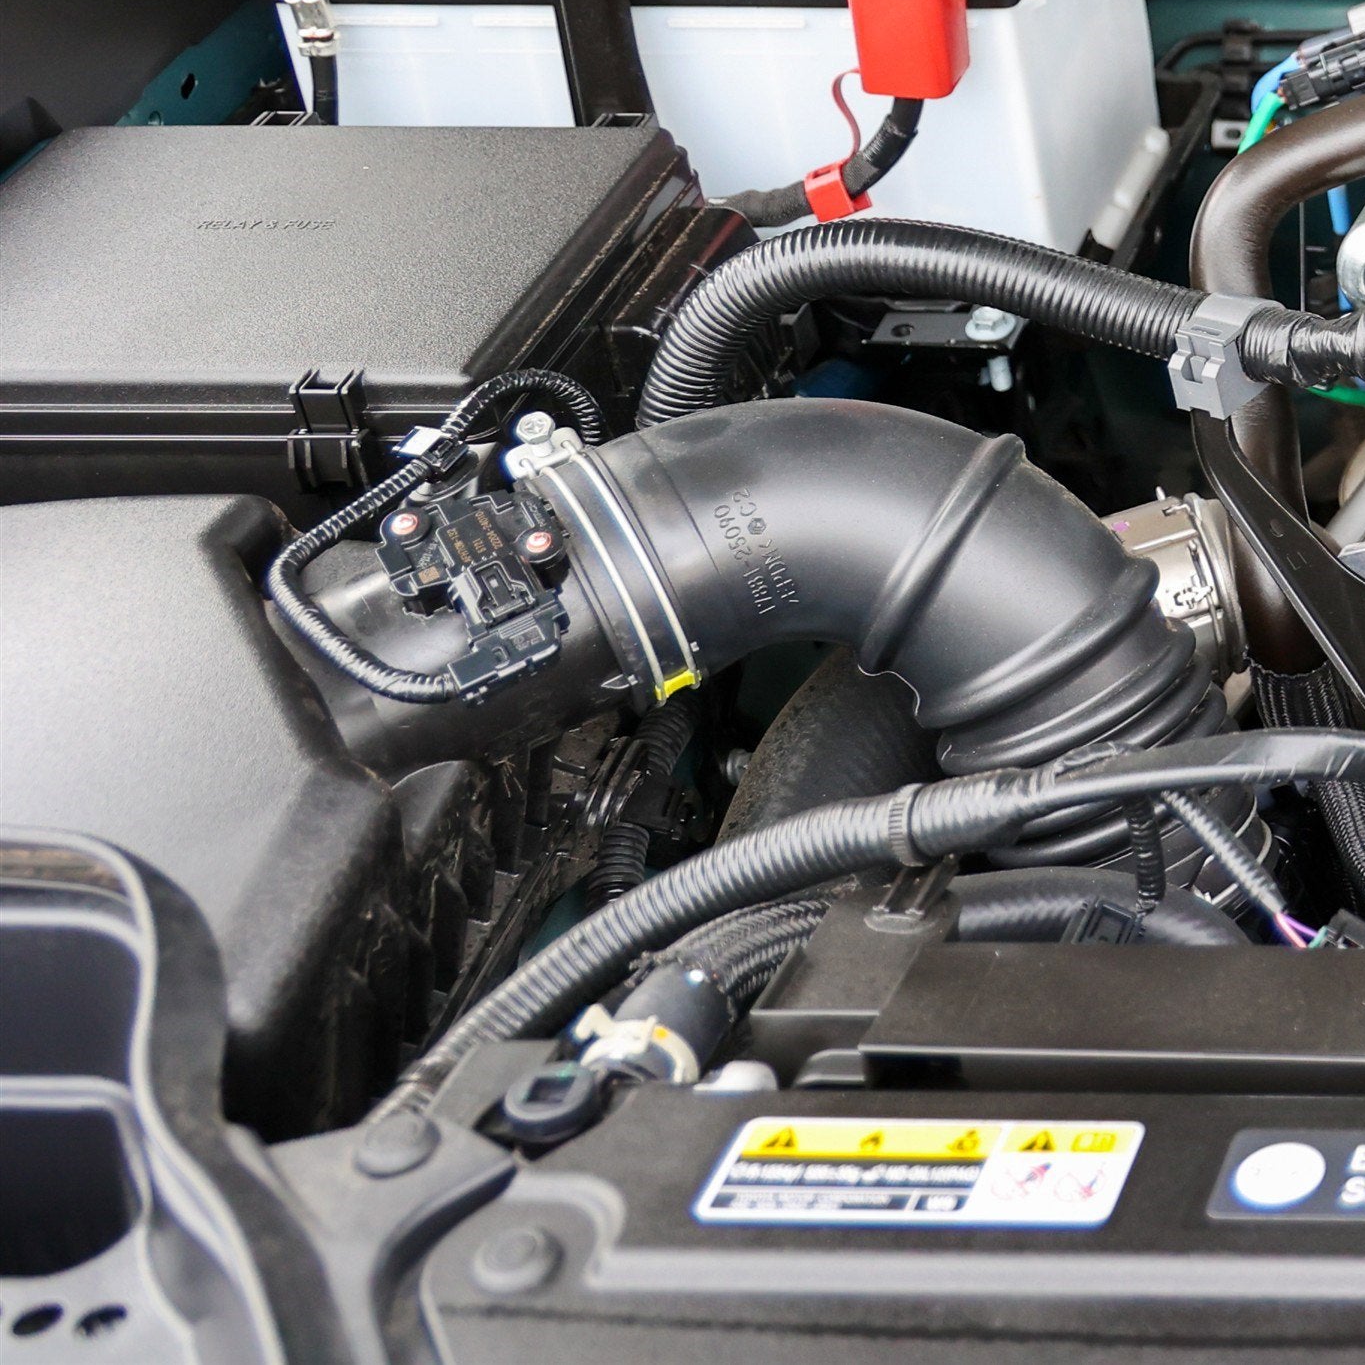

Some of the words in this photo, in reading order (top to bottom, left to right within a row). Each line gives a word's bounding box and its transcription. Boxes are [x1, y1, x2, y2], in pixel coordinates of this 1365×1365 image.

[197, 220, 263, 230] RELAY
[265, 219, 279, 230] &
[283, 219, 336, 230] FUSE
